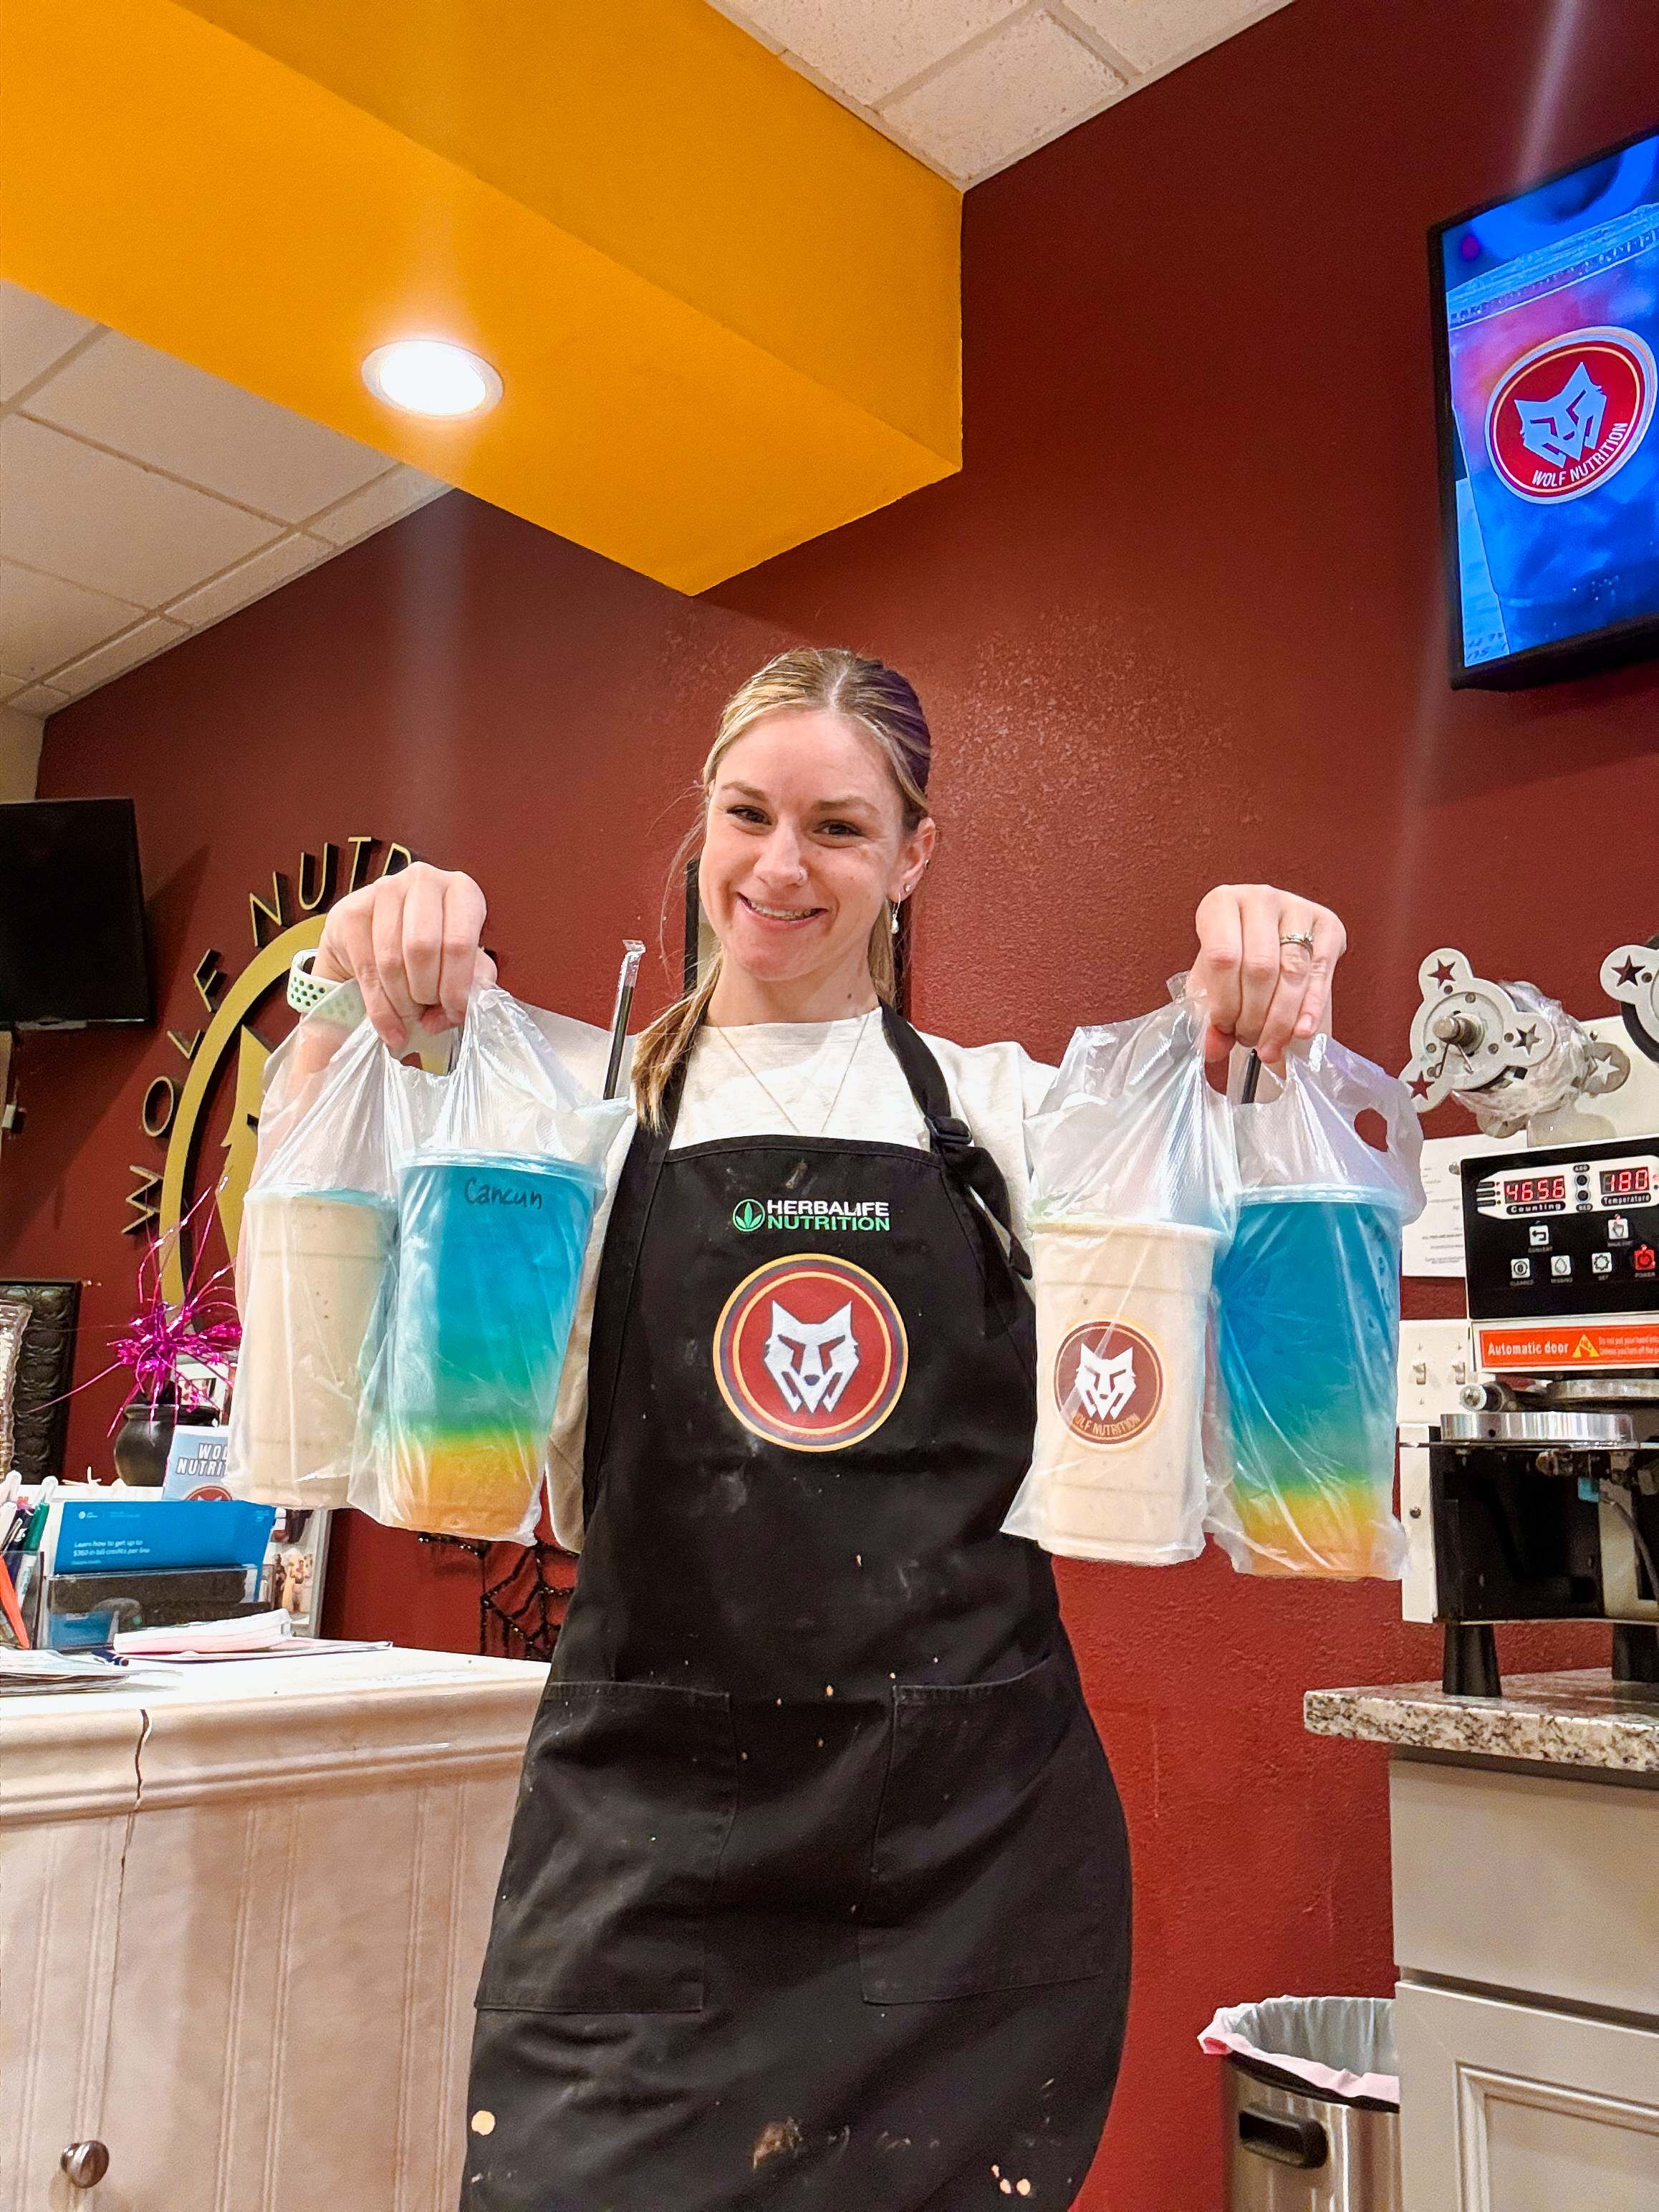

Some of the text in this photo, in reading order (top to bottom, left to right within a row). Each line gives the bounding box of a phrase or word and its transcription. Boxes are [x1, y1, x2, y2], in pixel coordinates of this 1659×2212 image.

[1531, 422, 1628, 487] WOLF NUTRITION
[121, 948, 221, 1234] WOLF
[1506, 1175, 1565, 1201] 4656
[1610, 1169, 1648, 1193] 180
[464, 1176, 542, 1210] Cancun
[1603, 1194, 1650, 1205] Temperature
[766, 1199, 890, 1217] HERBALIFE
[1511, 1203, 1562, 1213] Counting
[767, 1215, 890, 1231] NUTRITION
[1488, 1340, 1569, 1355] Automatic door
[1092, 1413, 1141, 1436] NUTRITION
